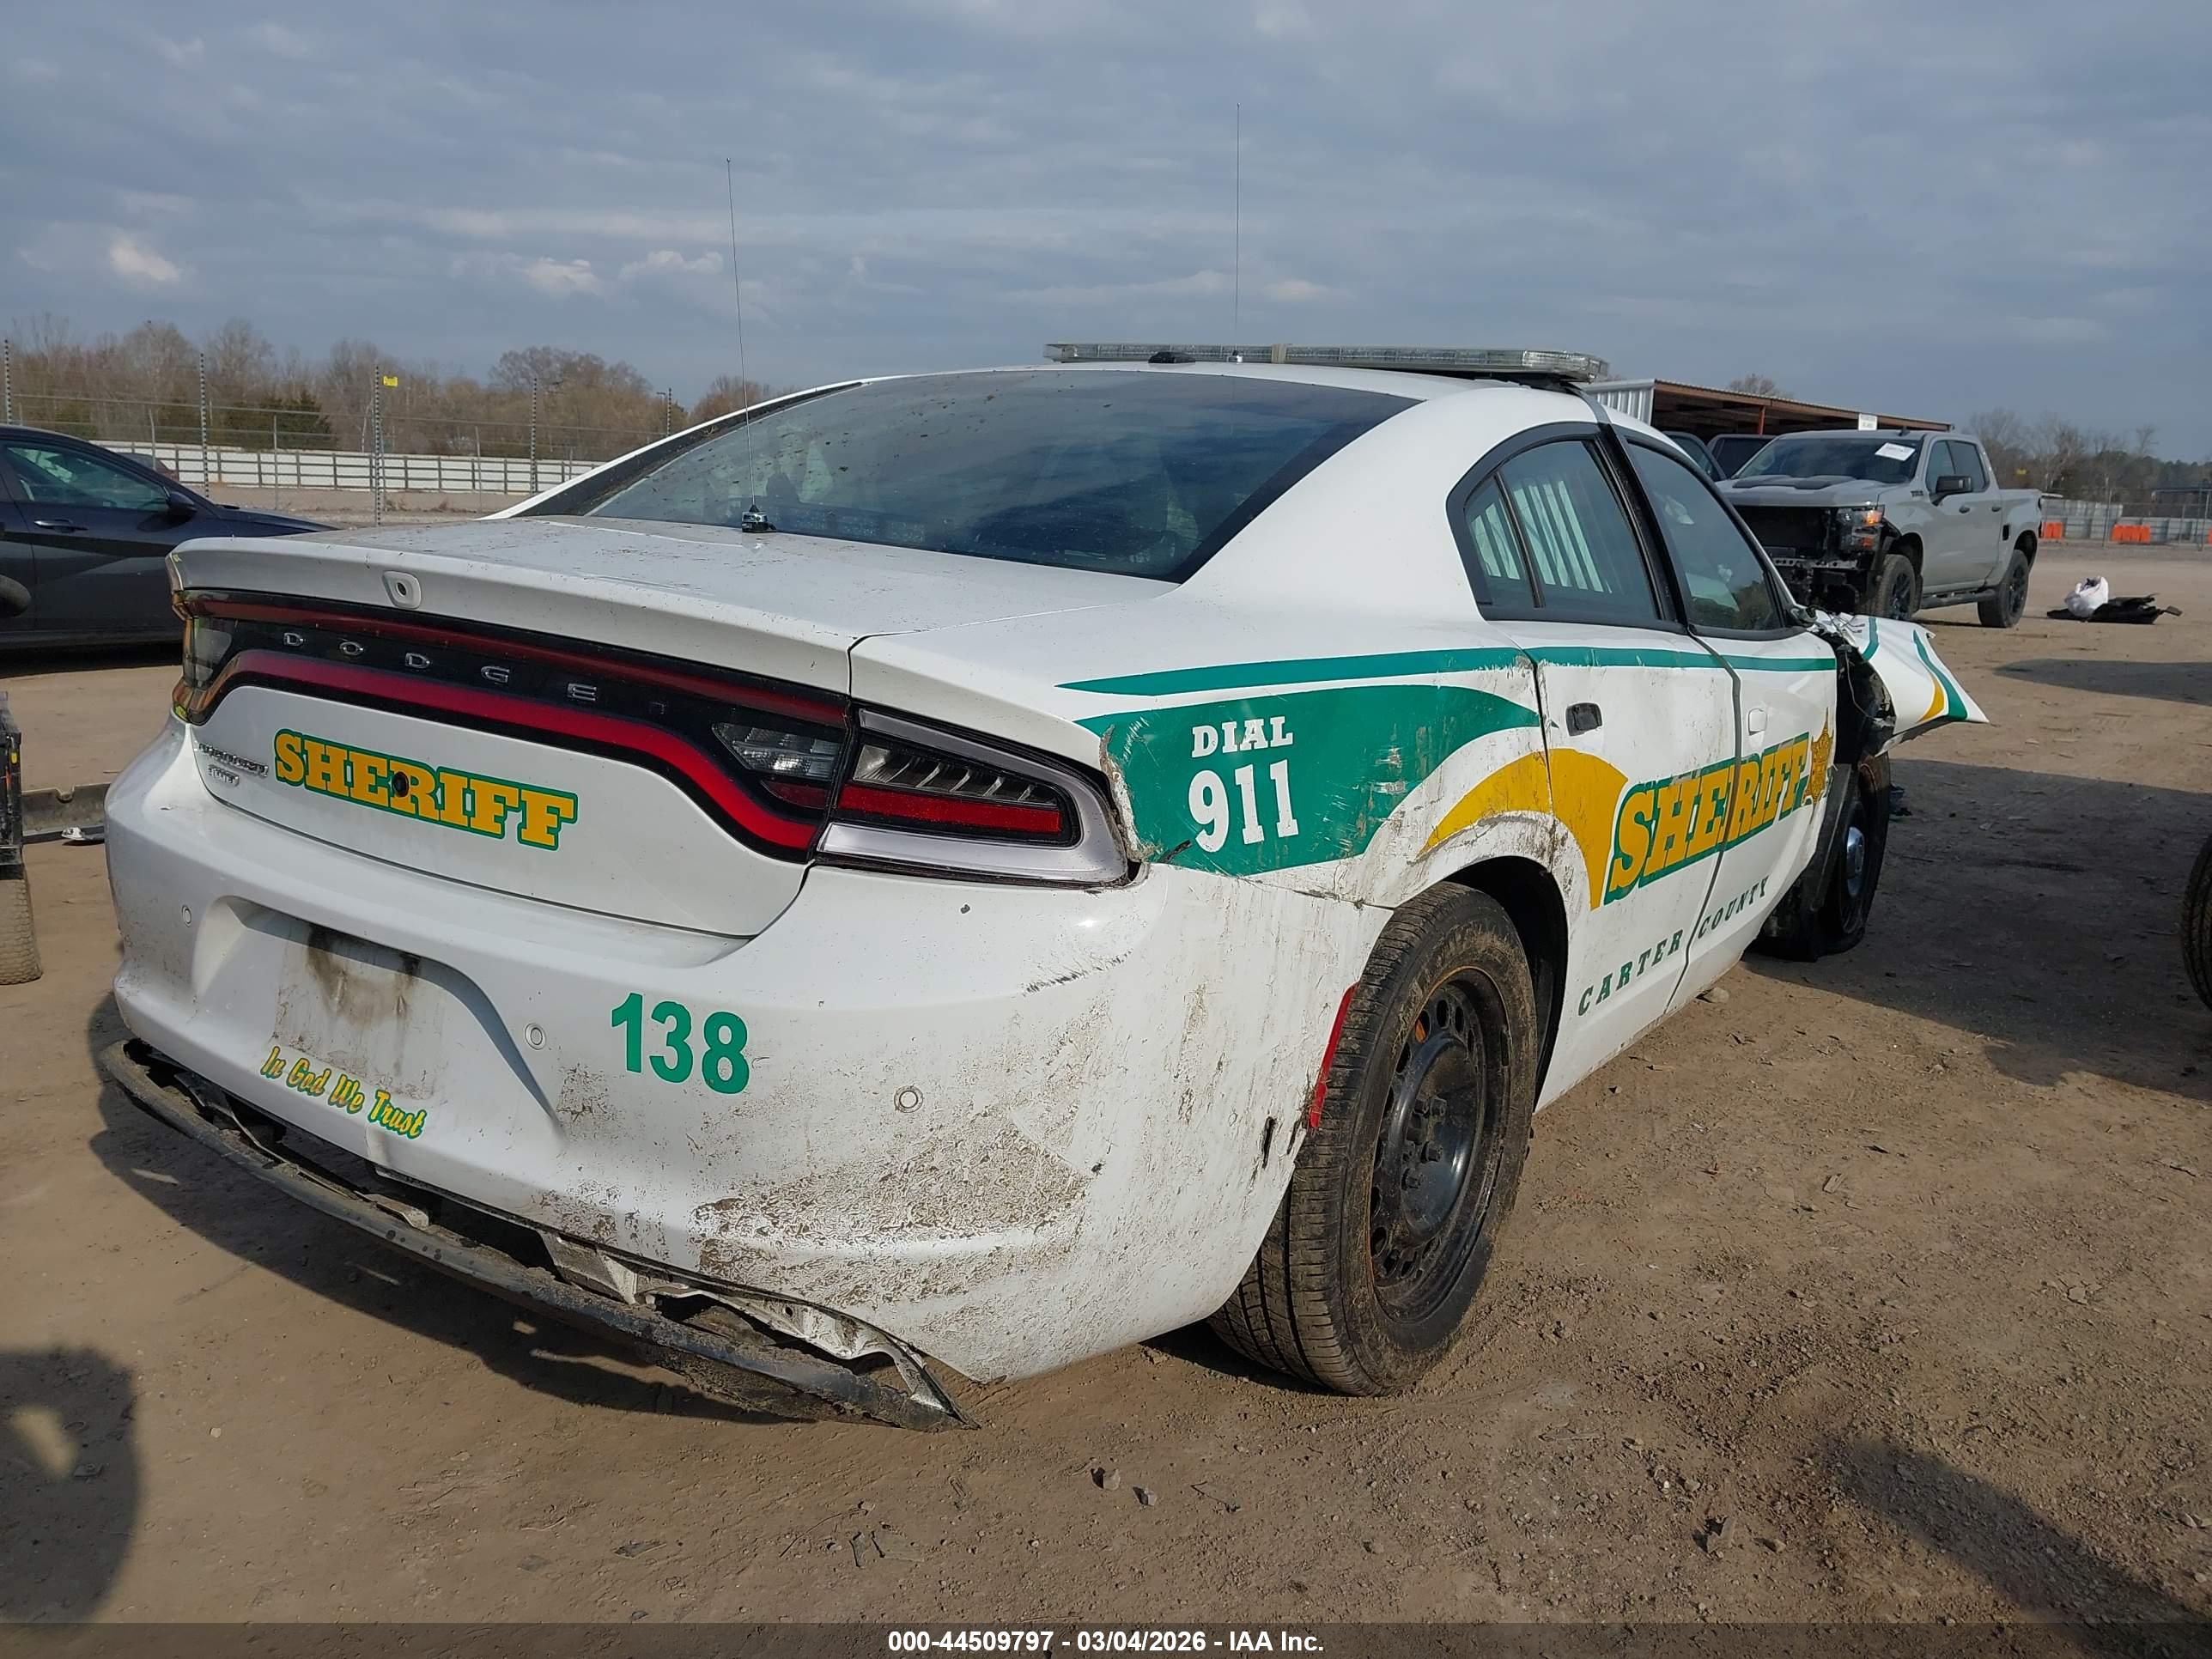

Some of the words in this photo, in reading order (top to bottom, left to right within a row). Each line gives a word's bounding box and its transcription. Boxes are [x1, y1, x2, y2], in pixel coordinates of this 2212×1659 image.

[283, 632, 598, 703] DODGE
[1191, 715, 1294, 758] DIAL
[274, 728, 578, 851] SHERIFF
[1188, 759, 1299, 853] 911
[1604, 732, 1809, 905] SHERIFF
[1578, 928, 1684, 1017] CARTER
[1697, 875, 1771, 940] COUNTY
[260, 1046, 286, 1079] In
[286, 1057, 331, 1097] God
[327, 1074, 365, 1115] We
[368, 1089, 428, 1139] Trust
[611, 992, 750, 1096] 138
